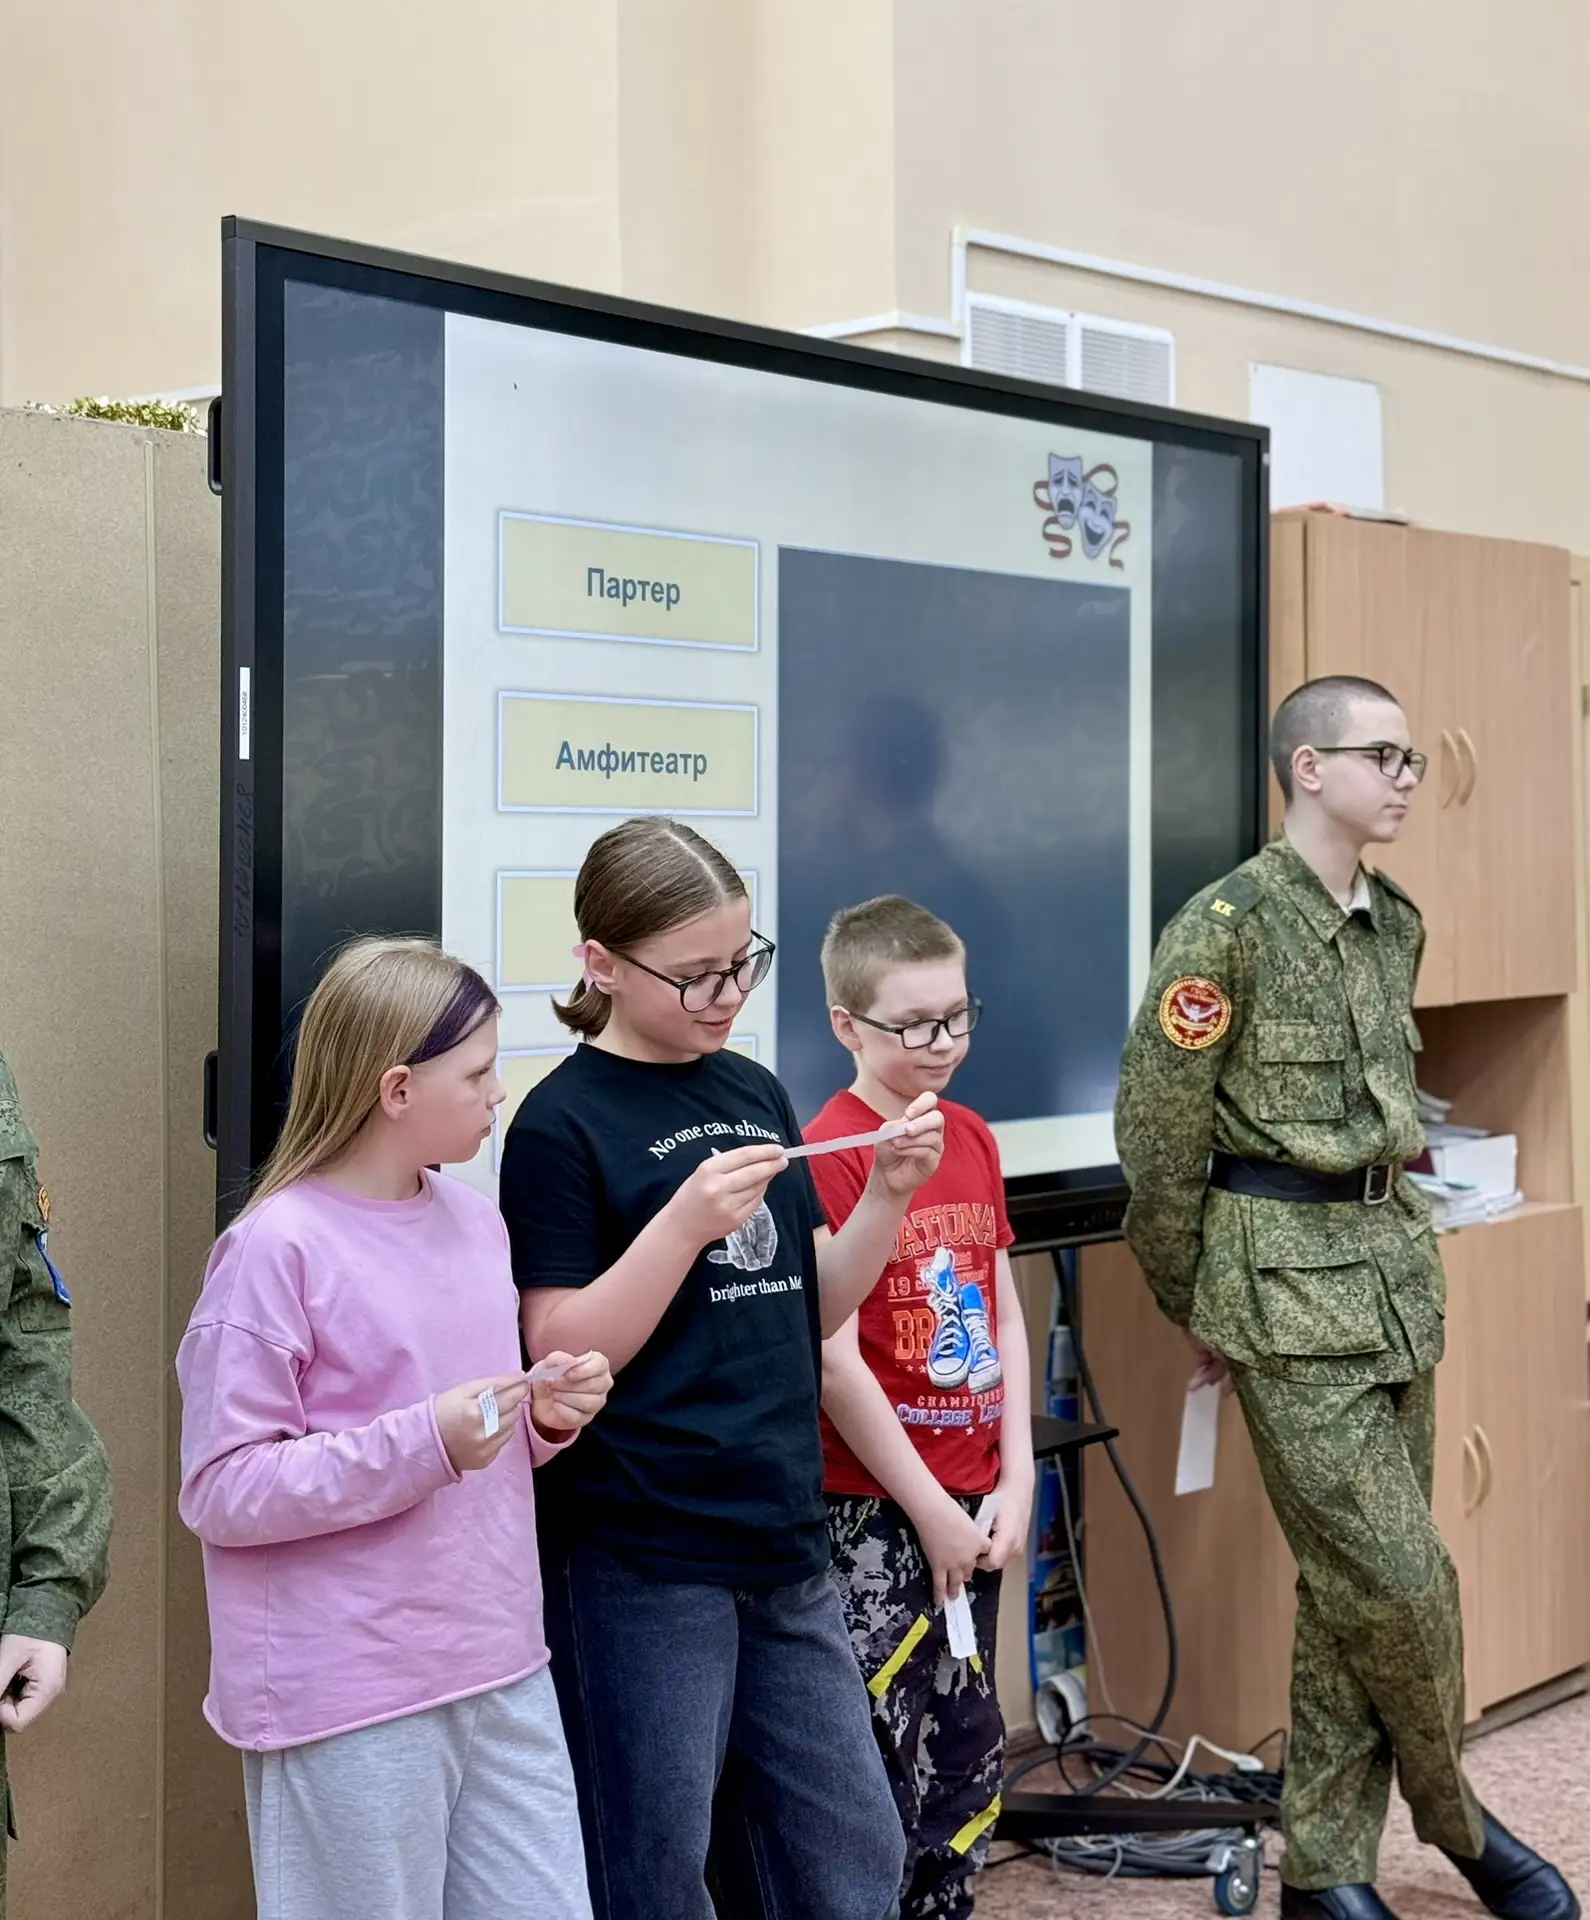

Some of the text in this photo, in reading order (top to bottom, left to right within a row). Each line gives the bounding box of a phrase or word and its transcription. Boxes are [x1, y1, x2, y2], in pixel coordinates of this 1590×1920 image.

[587, 566, 681, 612] Партер
[555, 740, 708, 782] Амфитеатр
[648, 1119, 781, 1160] No one can shine
[709, 1282, 757, 1302] brighter
[758, 1278, 788, 1294] than
